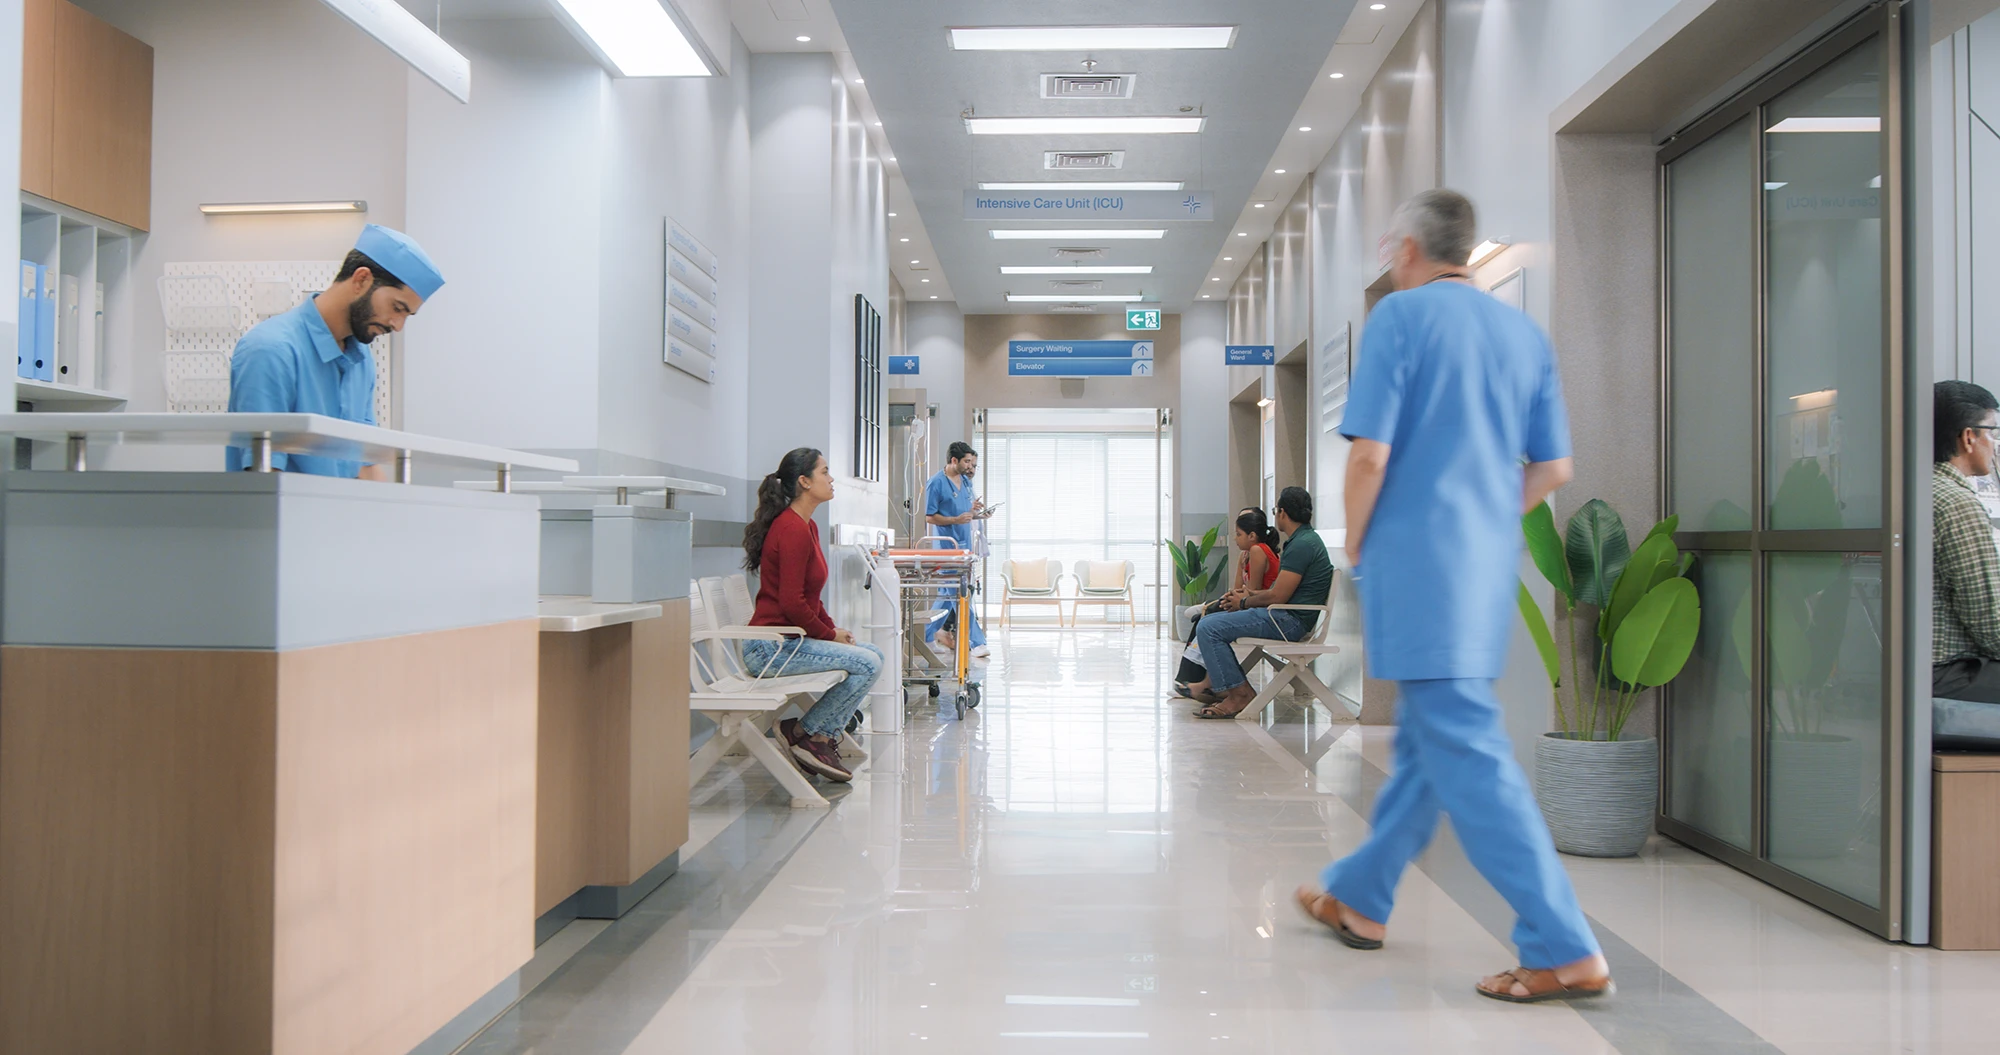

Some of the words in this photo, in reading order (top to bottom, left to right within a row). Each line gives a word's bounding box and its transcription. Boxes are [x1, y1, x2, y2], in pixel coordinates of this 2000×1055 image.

[976, 197, 1030, 209] Intensive
[1033, 197, 1063, 209] Care
[1065, 197, 1090, 209] Unit
[1093, 197, 1123, 211] (ICU)
[1016, 345, 1045, 353] Surgery
[1045, 345, 1073, 353] Waiting
